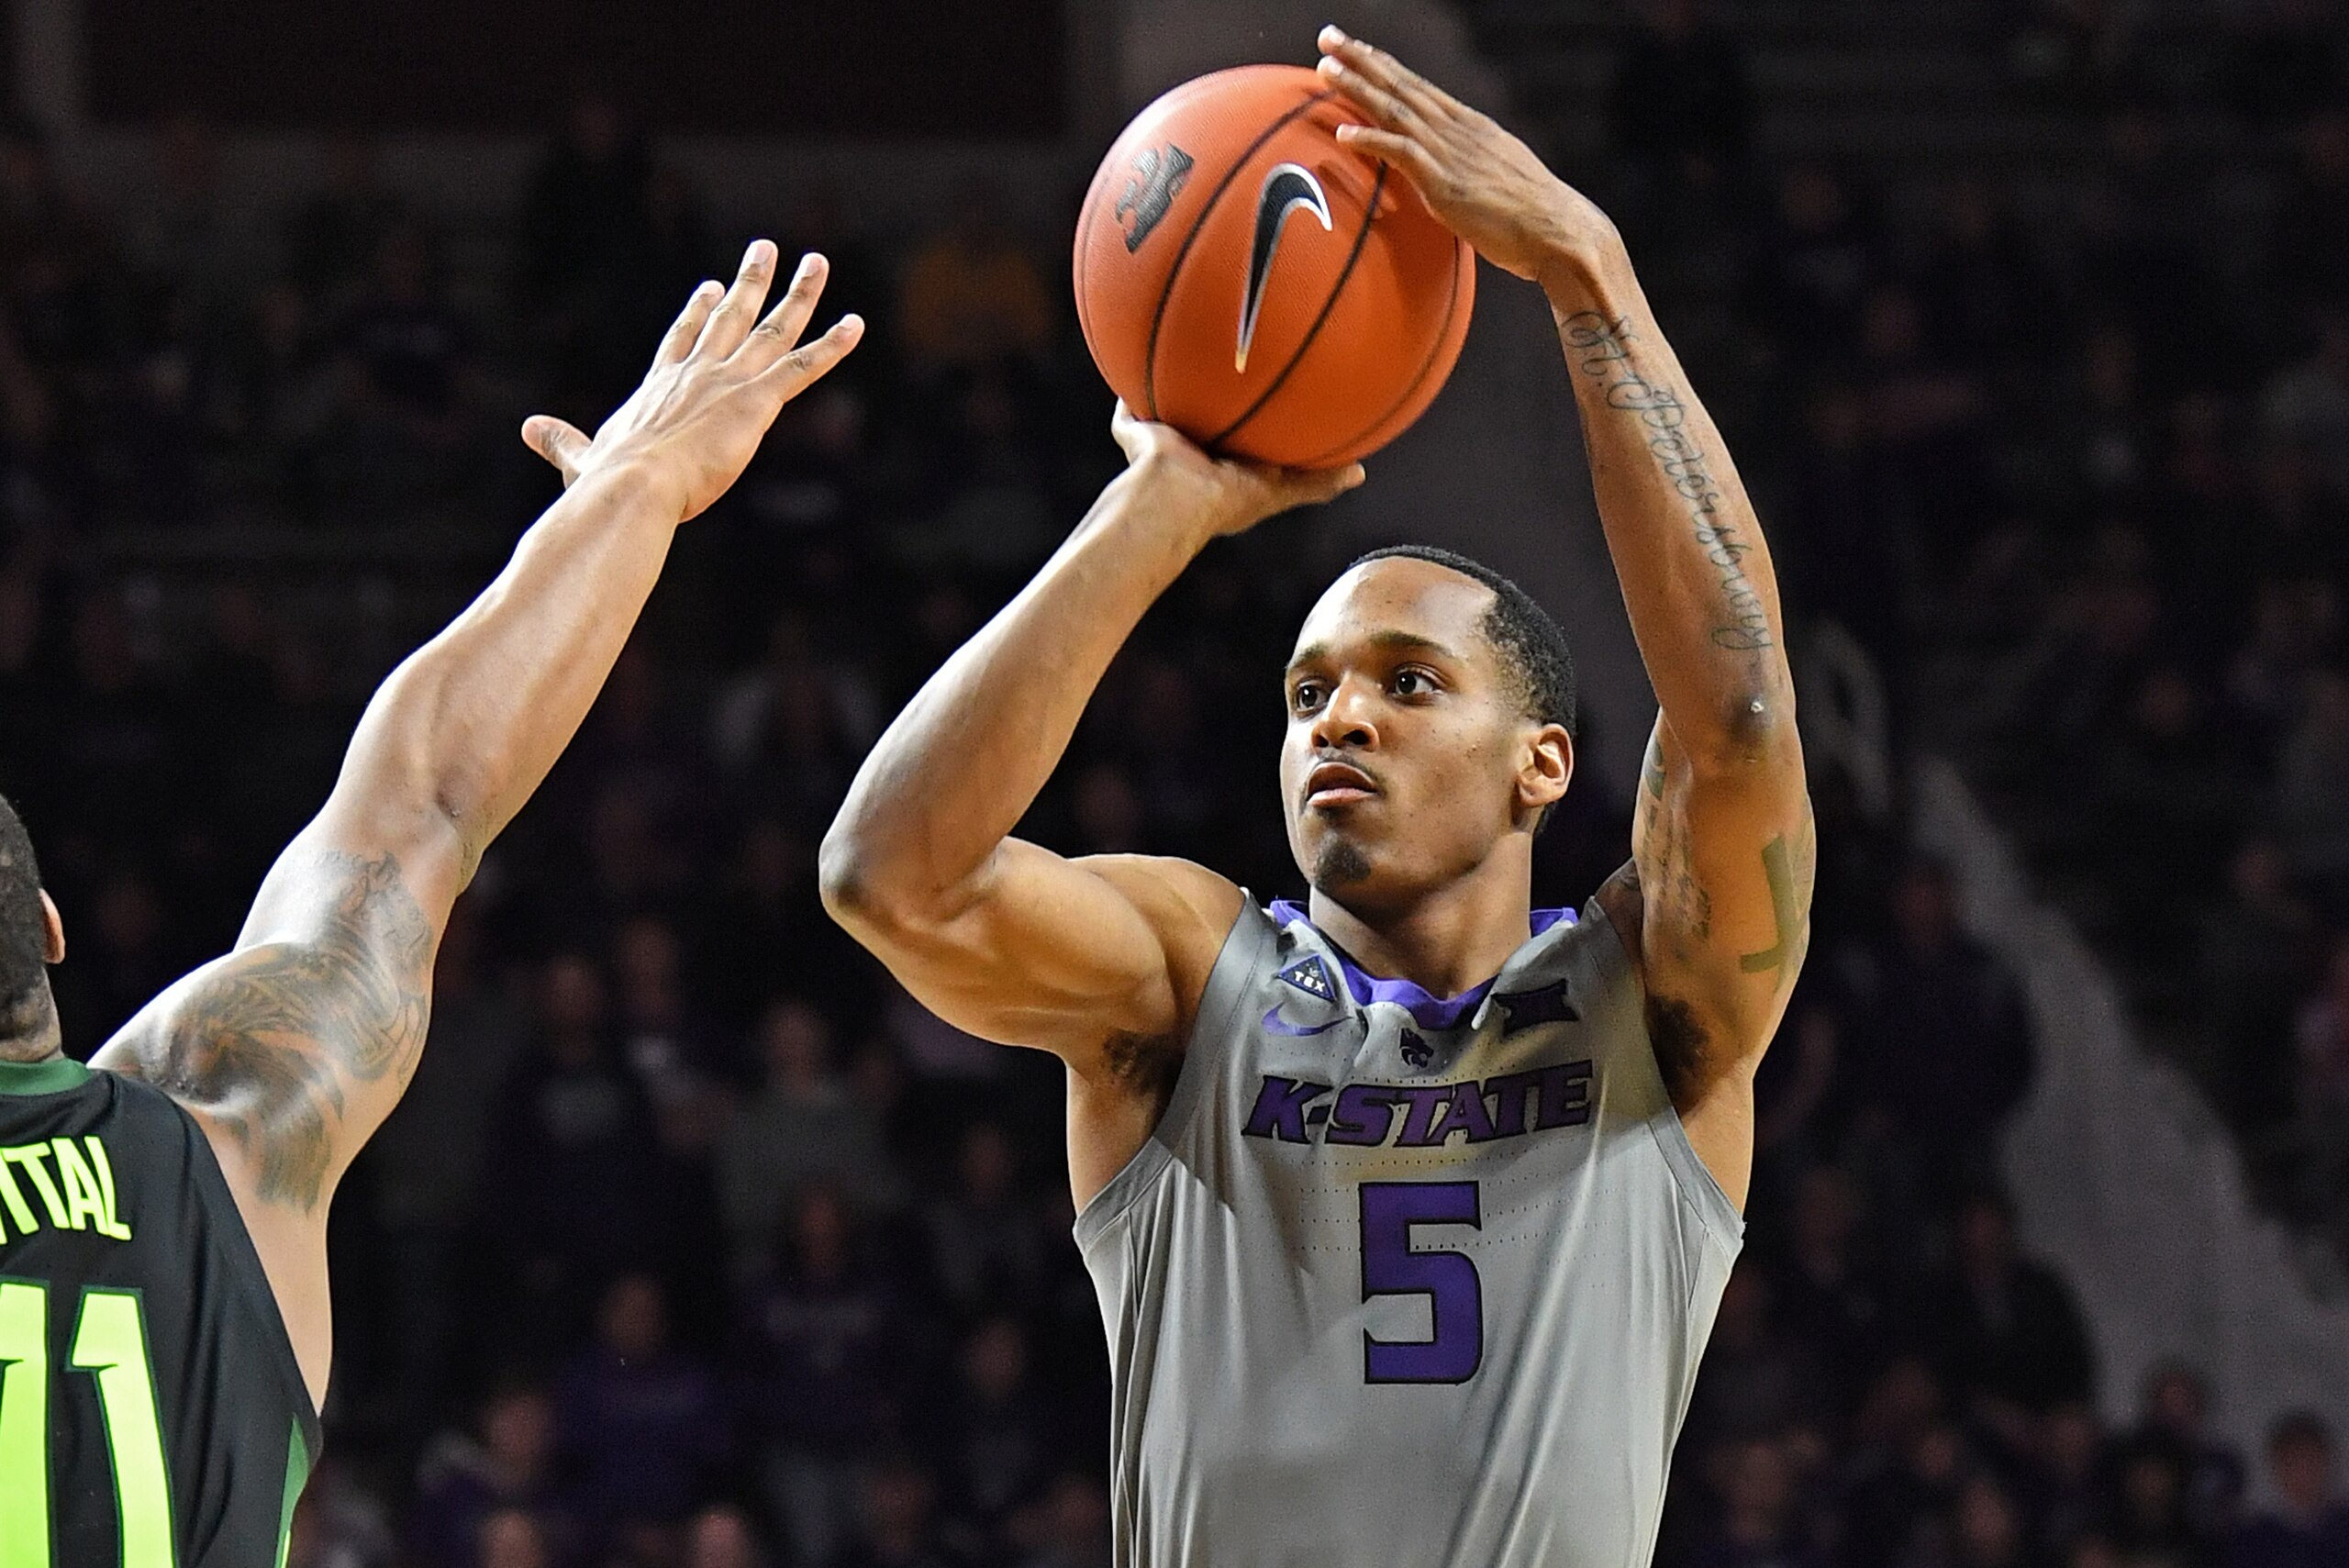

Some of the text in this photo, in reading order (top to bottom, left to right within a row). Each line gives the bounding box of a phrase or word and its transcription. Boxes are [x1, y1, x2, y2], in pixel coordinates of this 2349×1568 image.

[1241, 1059, 1593, 1148] K-STATE
[1358, 1180, 1485, 1386] 5
[0, 1279, 176, 1568] 11
